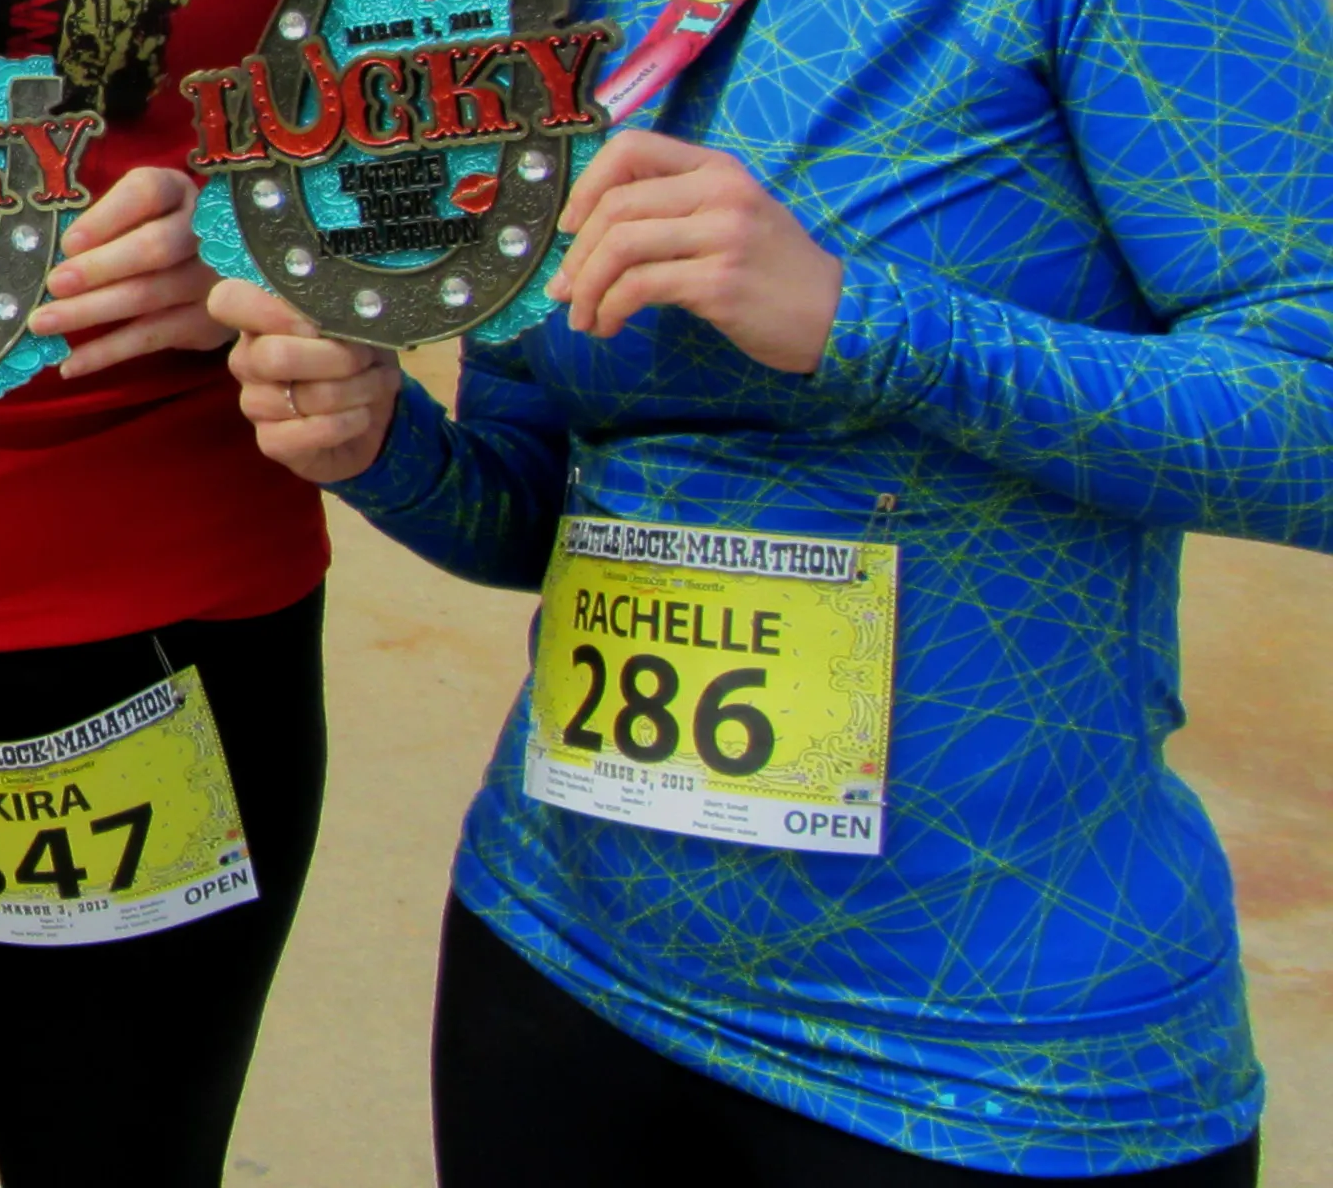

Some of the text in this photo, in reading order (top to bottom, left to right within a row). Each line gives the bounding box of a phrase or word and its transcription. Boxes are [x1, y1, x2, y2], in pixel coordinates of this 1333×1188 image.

[346, 22, 414, 45] MARCH
[182, 25, 617, 169] LUCKY
[338, 155, 446, 194] LITTLE
[358, 189, 436, 222] ROCK
[317, 217, 483, 259] MARATHON
[625, 525, 678, 560] ROCK
[686, 533, 852, 578] MARATHON
[573, 588, 782, 657] RACHELLE
[53, 683, 174, 759] MARATHON
[563, 644, 775, 778] 286
[593, 759, 695, 793] MARCH 3, 2013
[783, 810, 871, 840] OPEN
[184, 869, 249, 907] OPEN
[0, 903, 52, 917] MARCH
[78, 899, 110, 914] 2013
